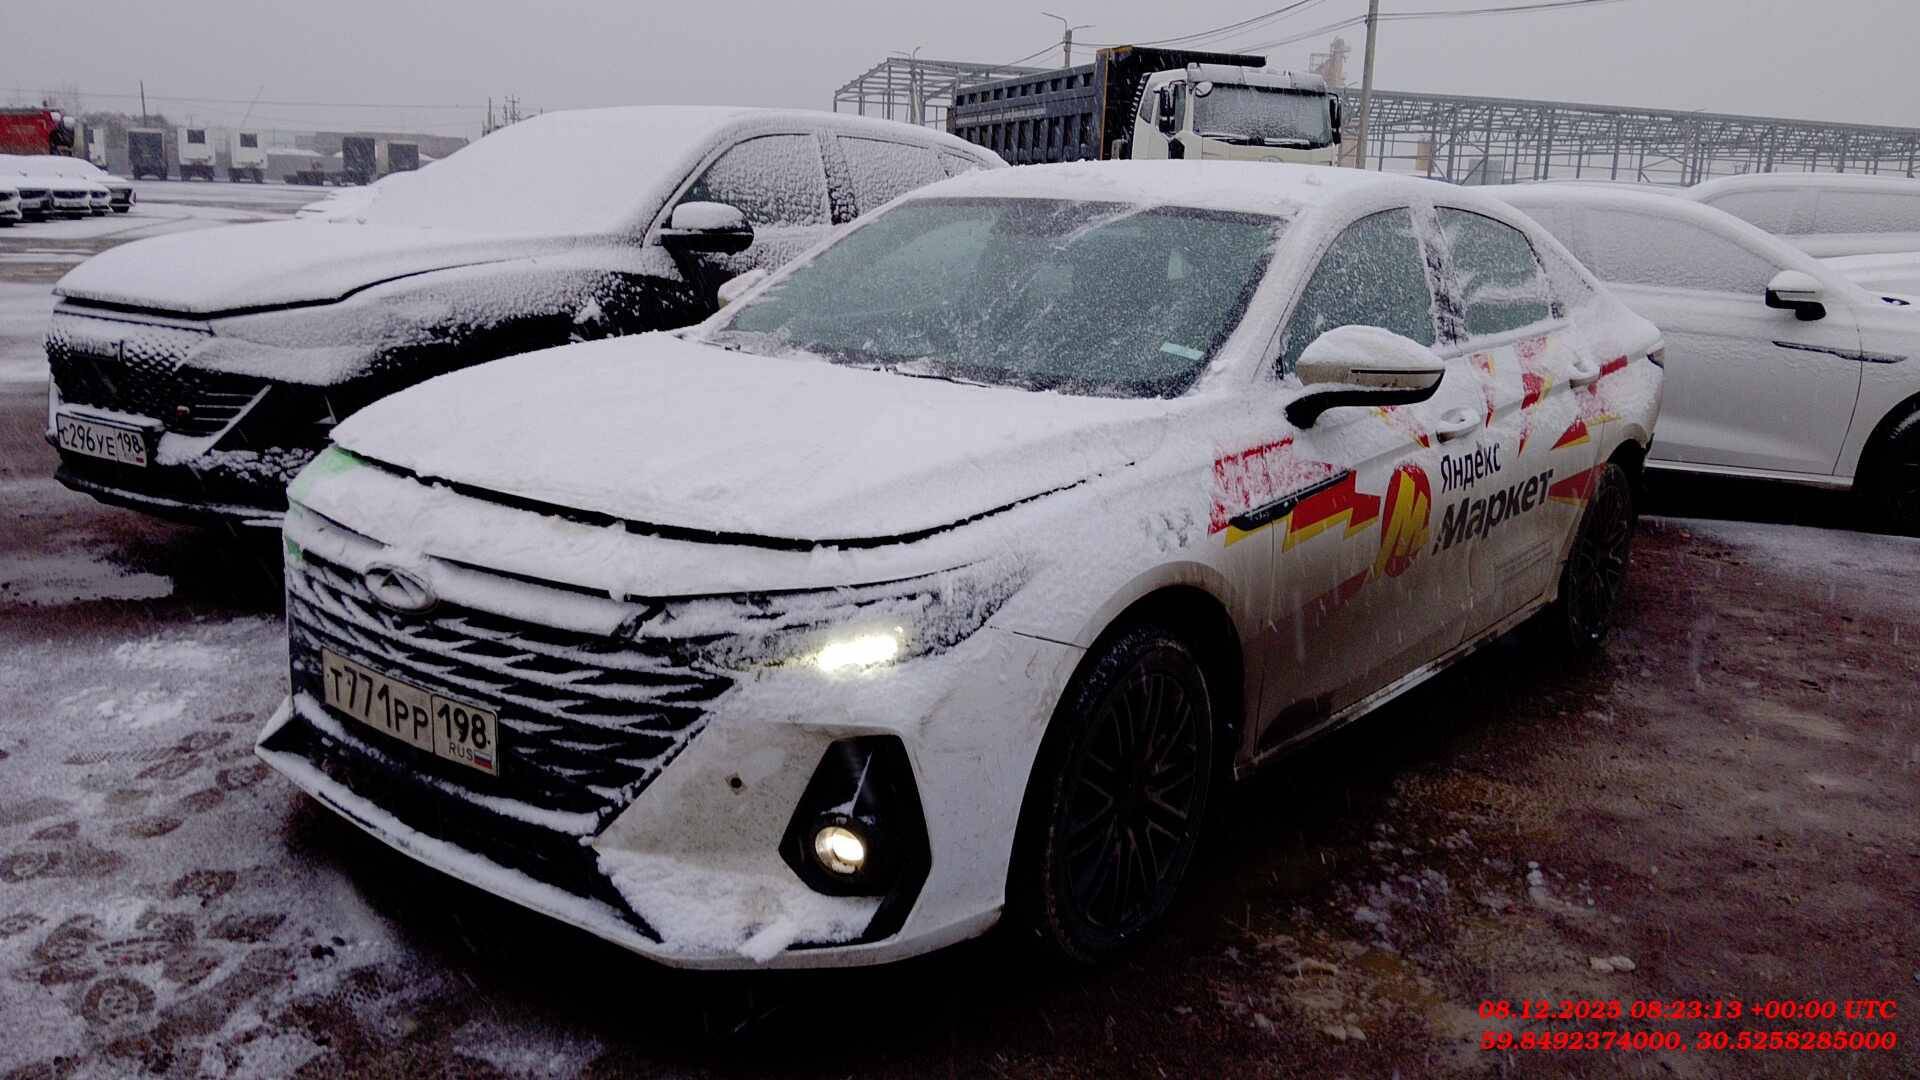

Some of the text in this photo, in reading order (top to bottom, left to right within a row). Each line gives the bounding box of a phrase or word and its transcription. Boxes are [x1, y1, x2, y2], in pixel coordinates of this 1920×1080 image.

[116, 431, 141, 455] 198
[1440, 443, 1502, 494] Яндекс
[1431, 469, 1554, 557] Маркет
[329, 665, 486, 750] Т771РР 198
[448, 741, 474, 762] RUS
